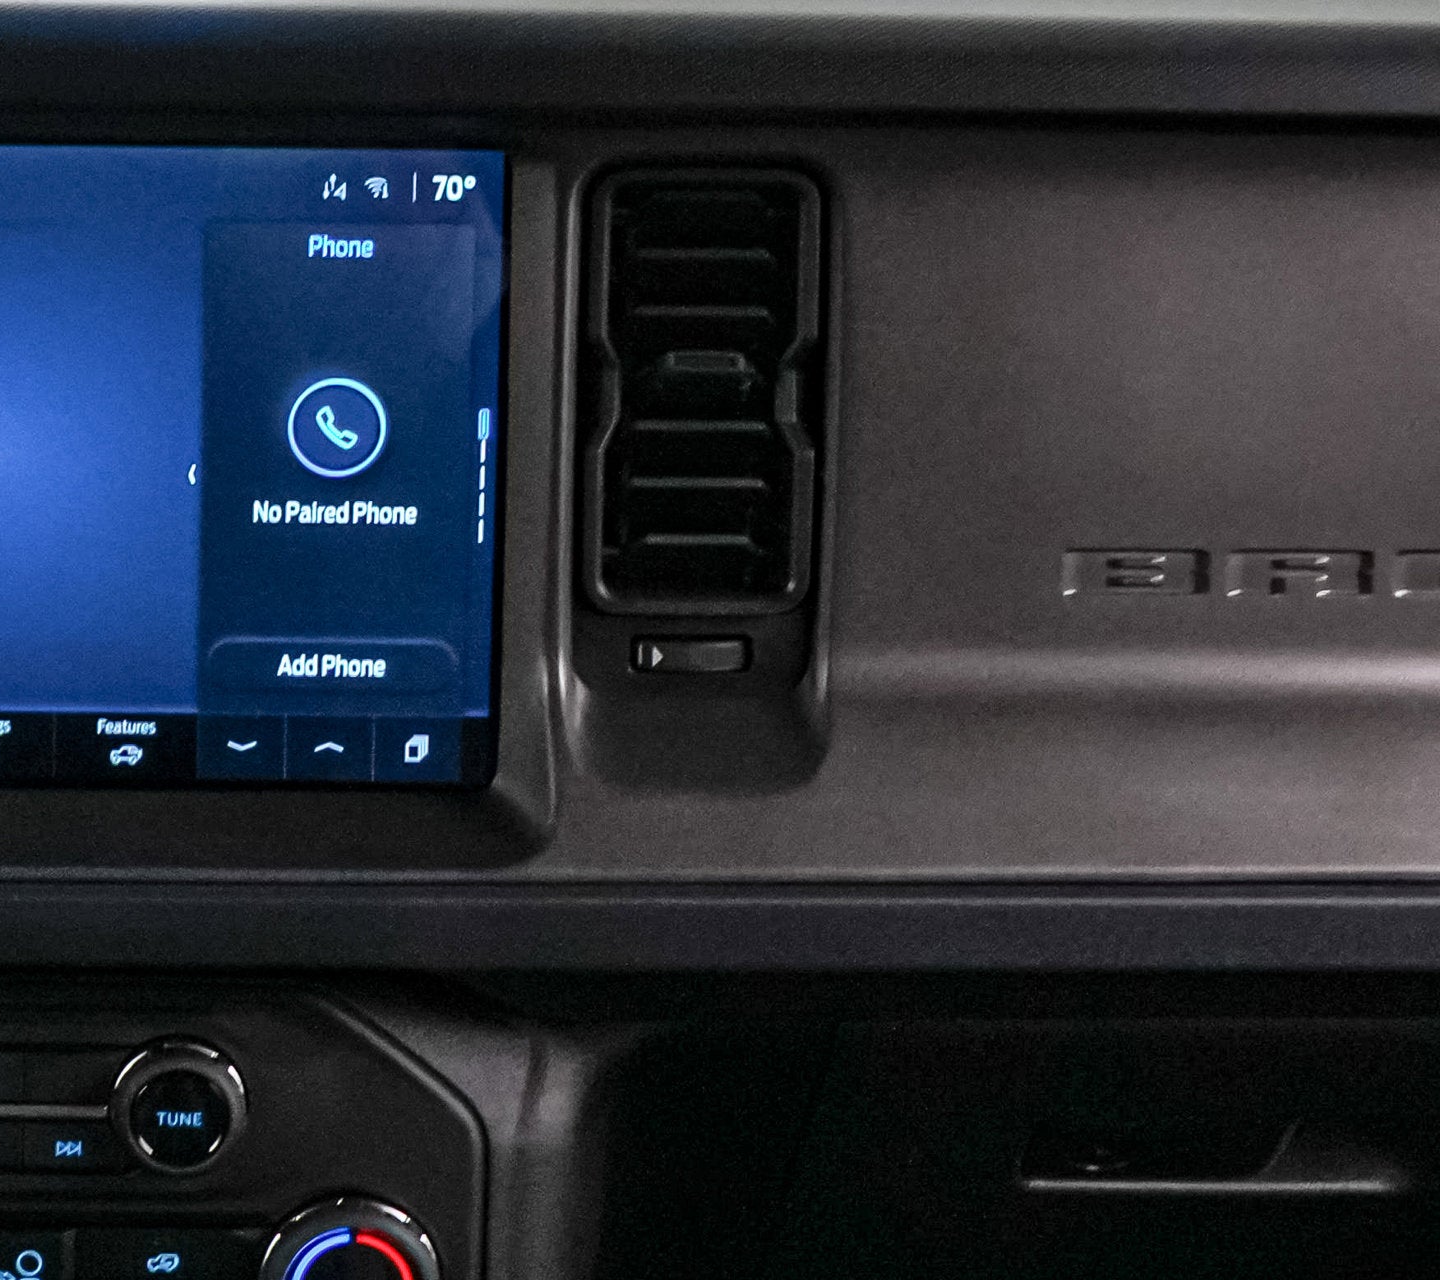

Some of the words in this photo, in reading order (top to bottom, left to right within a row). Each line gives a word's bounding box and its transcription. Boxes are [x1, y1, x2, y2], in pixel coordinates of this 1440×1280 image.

[308, 234, 375, 258] Phone
[252, 499, 282, 524] No
[285, 500, 350, 525] Paired
[352, 501, 417, 525] Phone
[277, 654, 318, 677] Add
[321, 654, 386, 678] Phone
[97, 718, 156, 735] Features
[156, 1112, 203, 1127] TUNE
